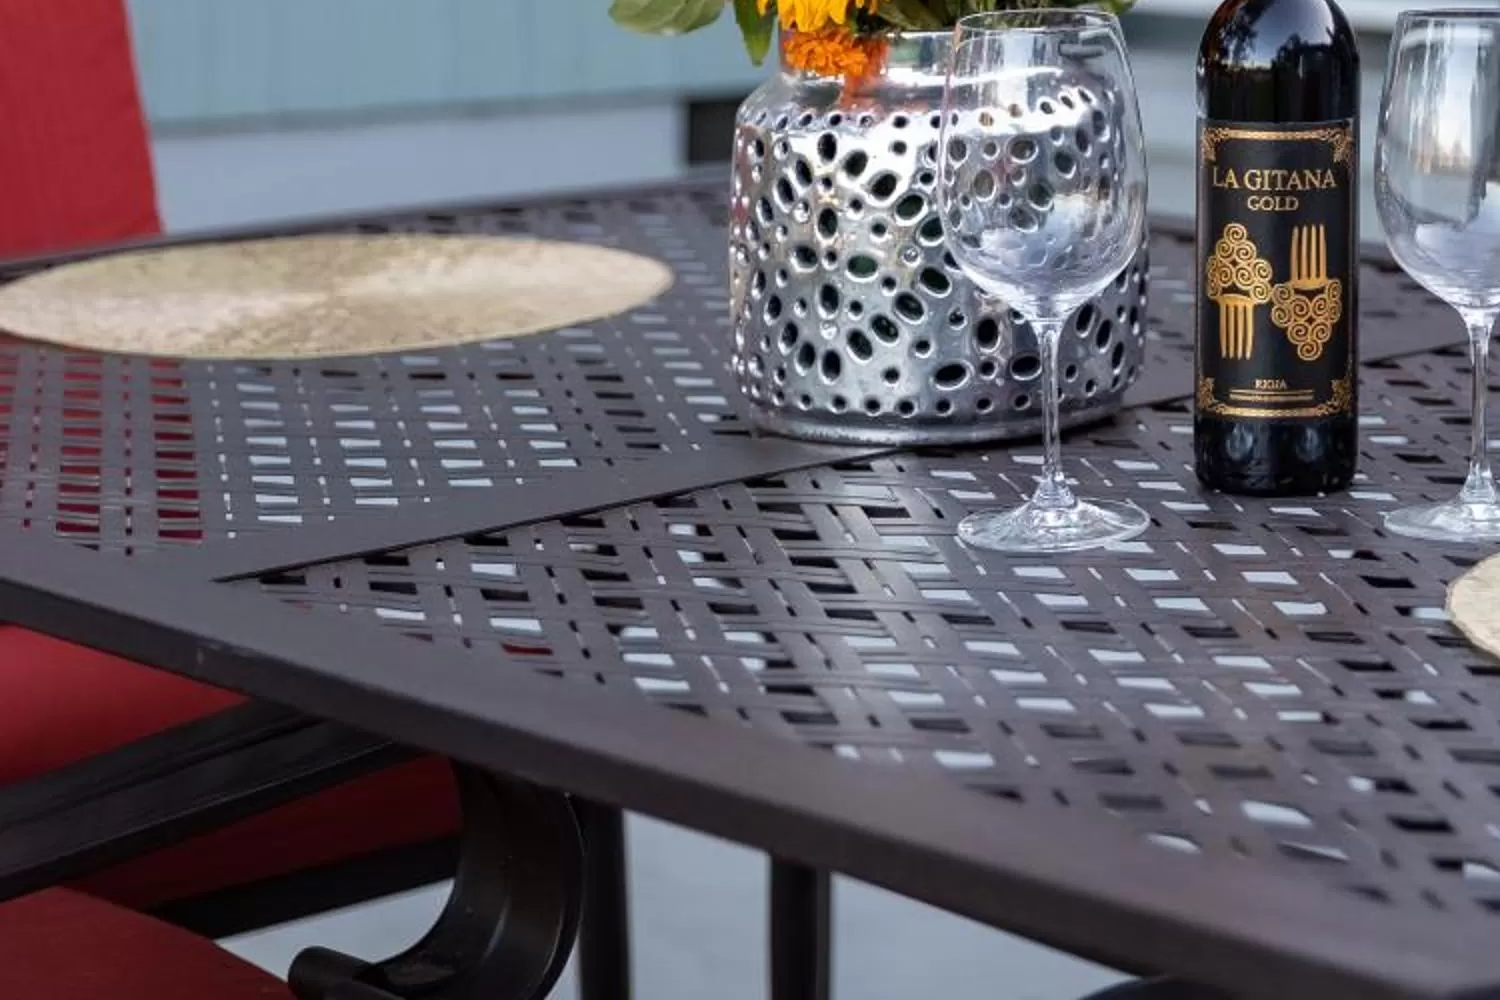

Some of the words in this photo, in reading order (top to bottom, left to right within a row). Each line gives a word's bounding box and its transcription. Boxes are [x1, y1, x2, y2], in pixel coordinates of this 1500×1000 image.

[1212, 166, 1240, 189] LA
[1243, 168, 1337, 191] GITANA
[1247, 195, 1299, 211] GOLD
